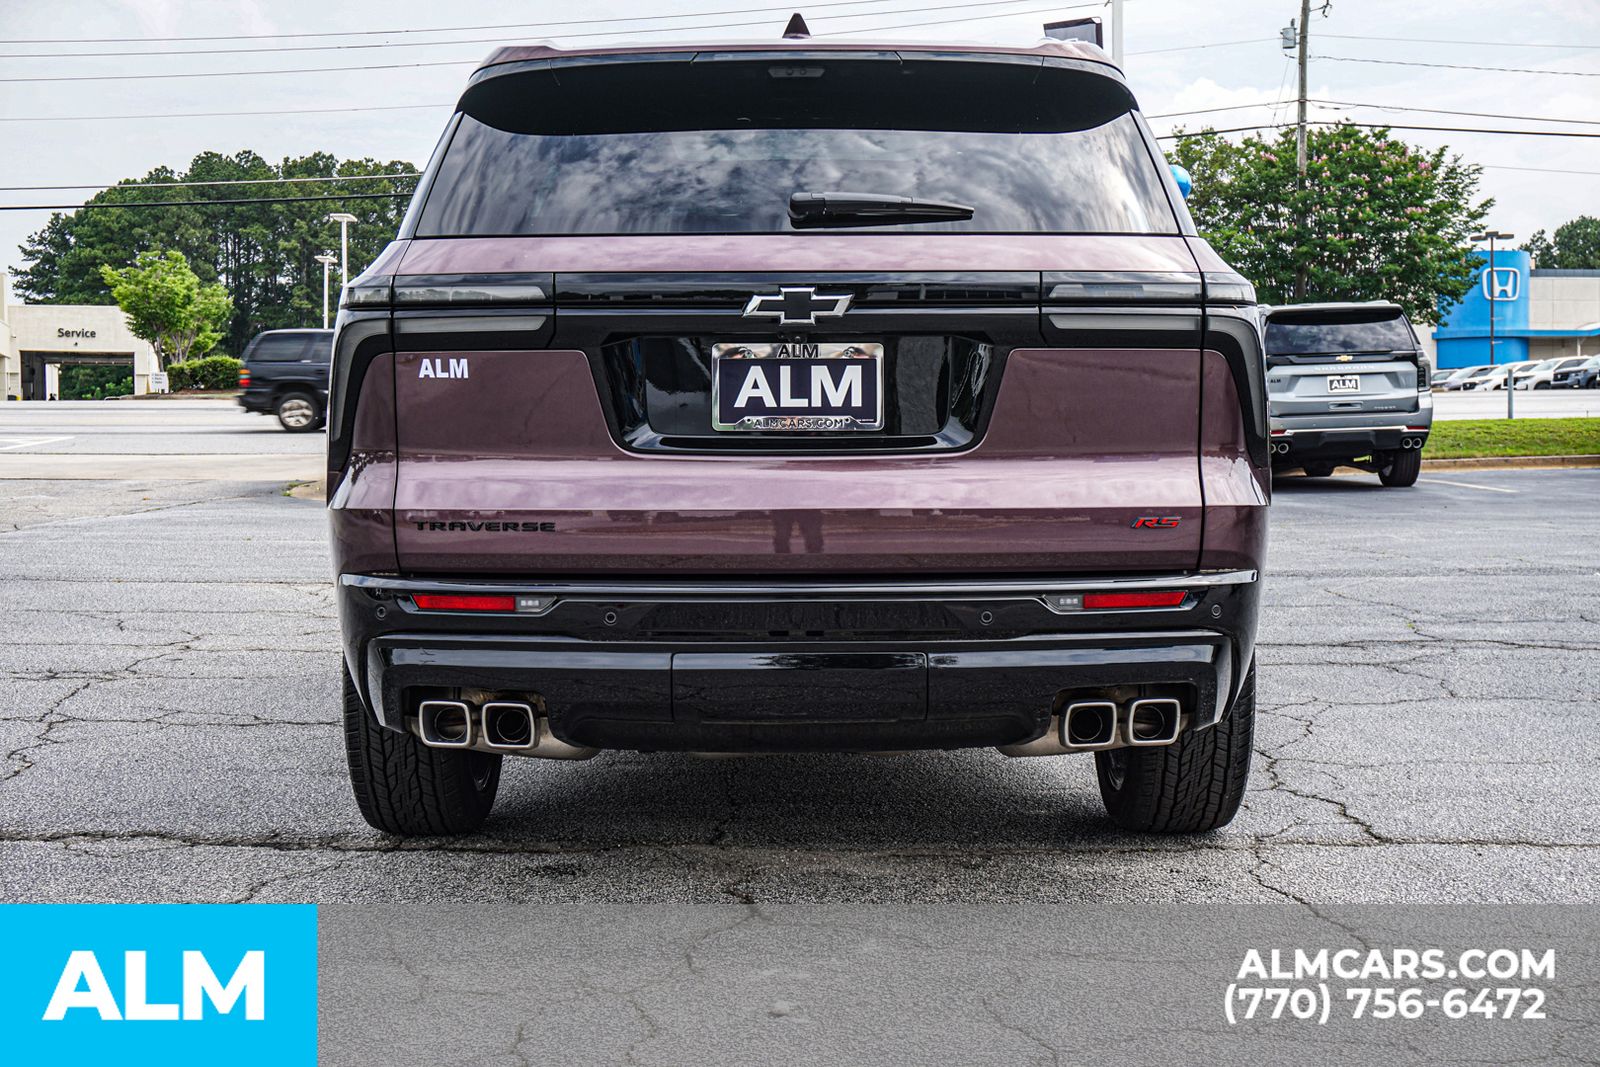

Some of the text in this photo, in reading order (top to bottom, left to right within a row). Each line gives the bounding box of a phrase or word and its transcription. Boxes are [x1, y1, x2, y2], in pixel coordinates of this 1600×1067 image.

[57, 327, 96, 338] Service
[777, 344, 819, 358] ALM
[418, 358, 469, 379] ALM
[733, 365, 863, 407] ALM
[1331, 379, 1357, 390] ALM
[752, 419, 846, 430] ALMCARS.COM
[416, 520, 556, 533] TRAVERSE
[1131, 516, 1182, 529] RS
